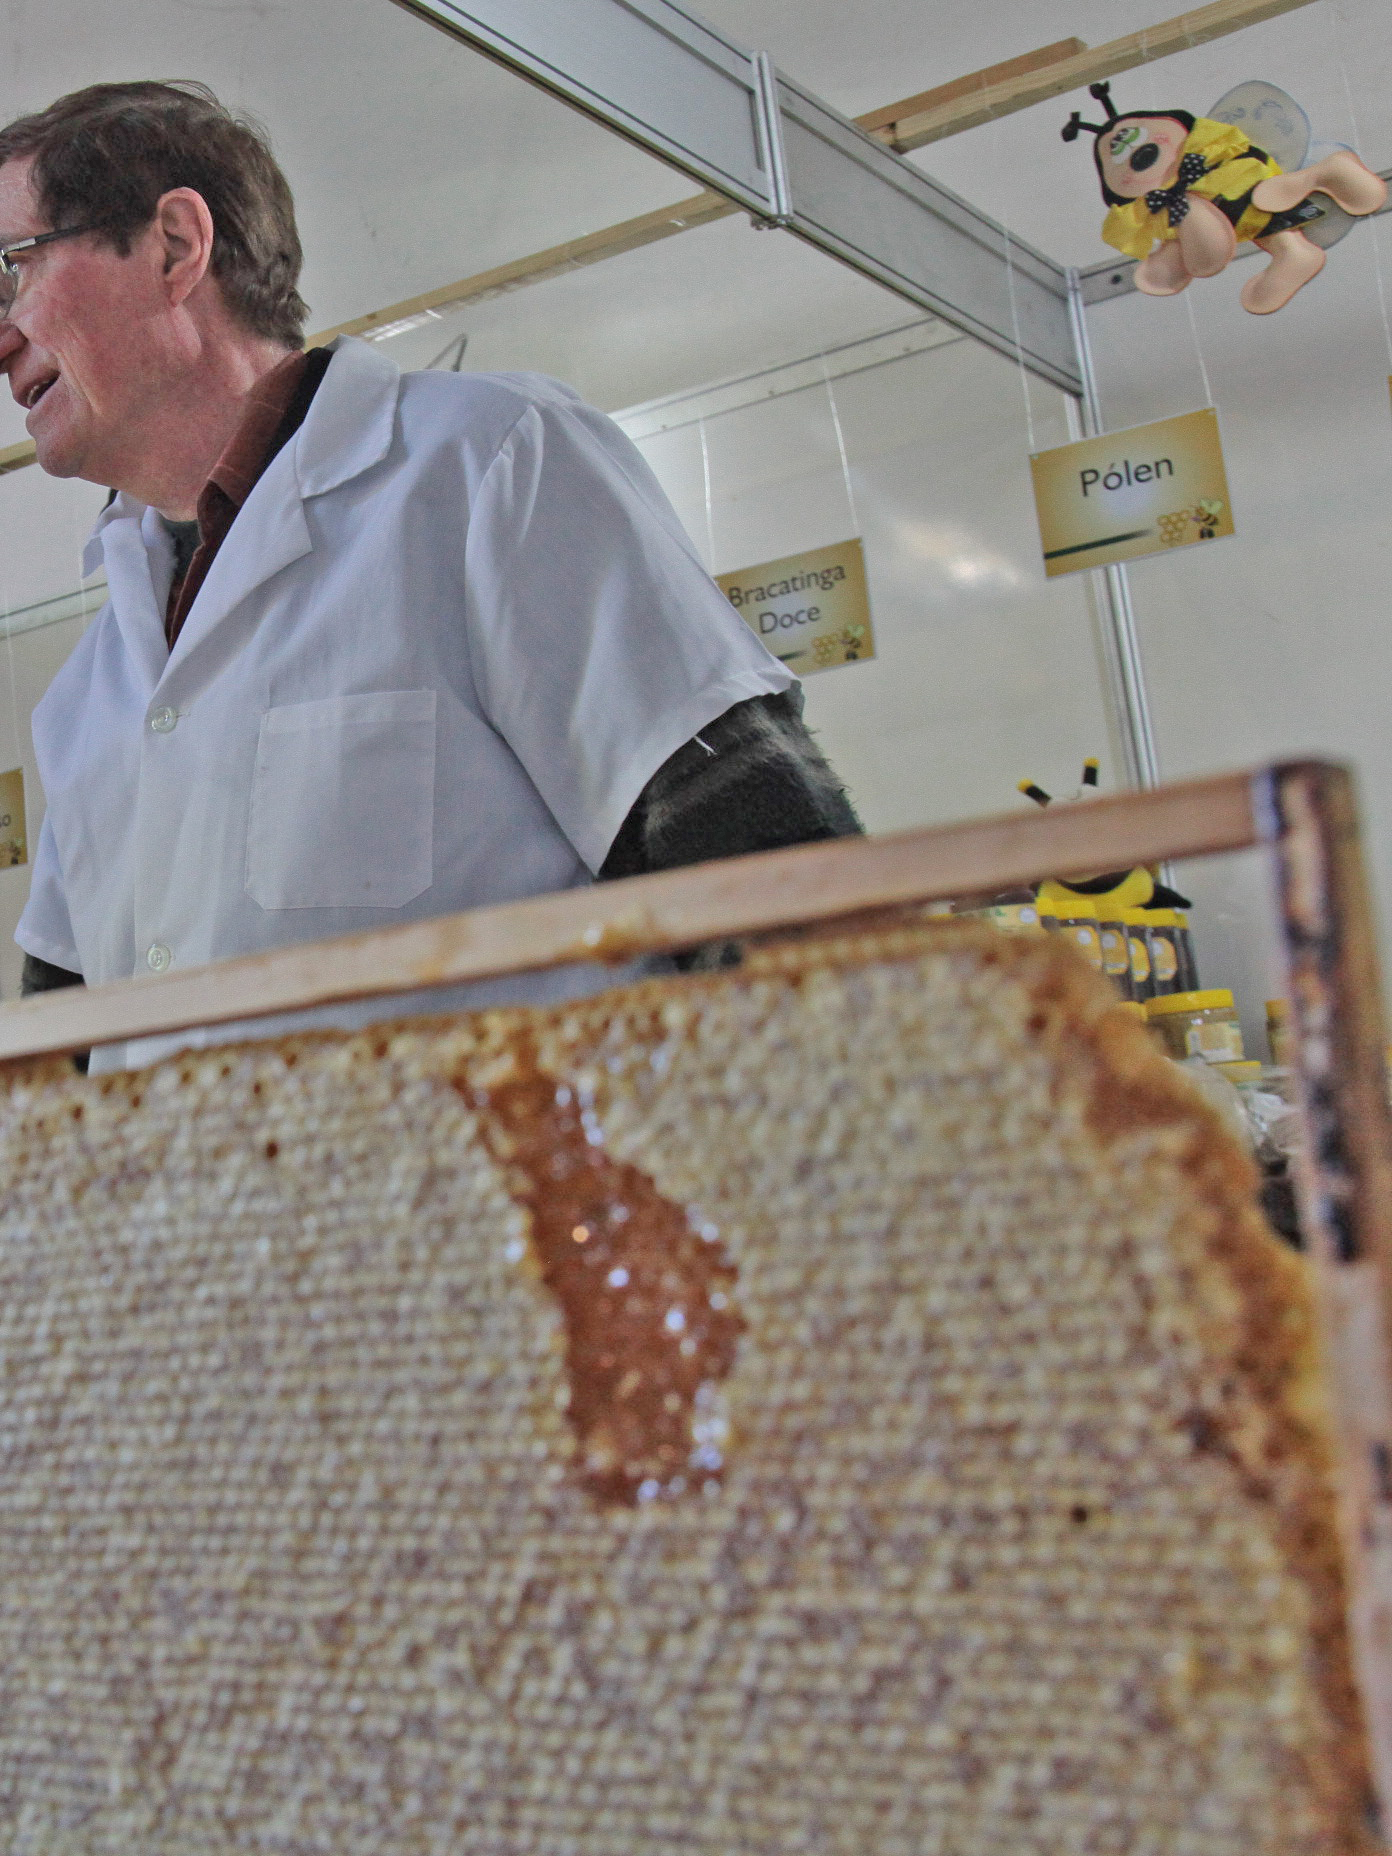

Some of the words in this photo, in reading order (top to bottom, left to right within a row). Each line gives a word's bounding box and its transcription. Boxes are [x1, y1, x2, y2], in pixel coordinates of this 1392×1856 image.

[1080, 457, 1174, 497] Pólen
[728, 565, 847, 608] Bracatinga
[759, 606, 820, 634] Doce
